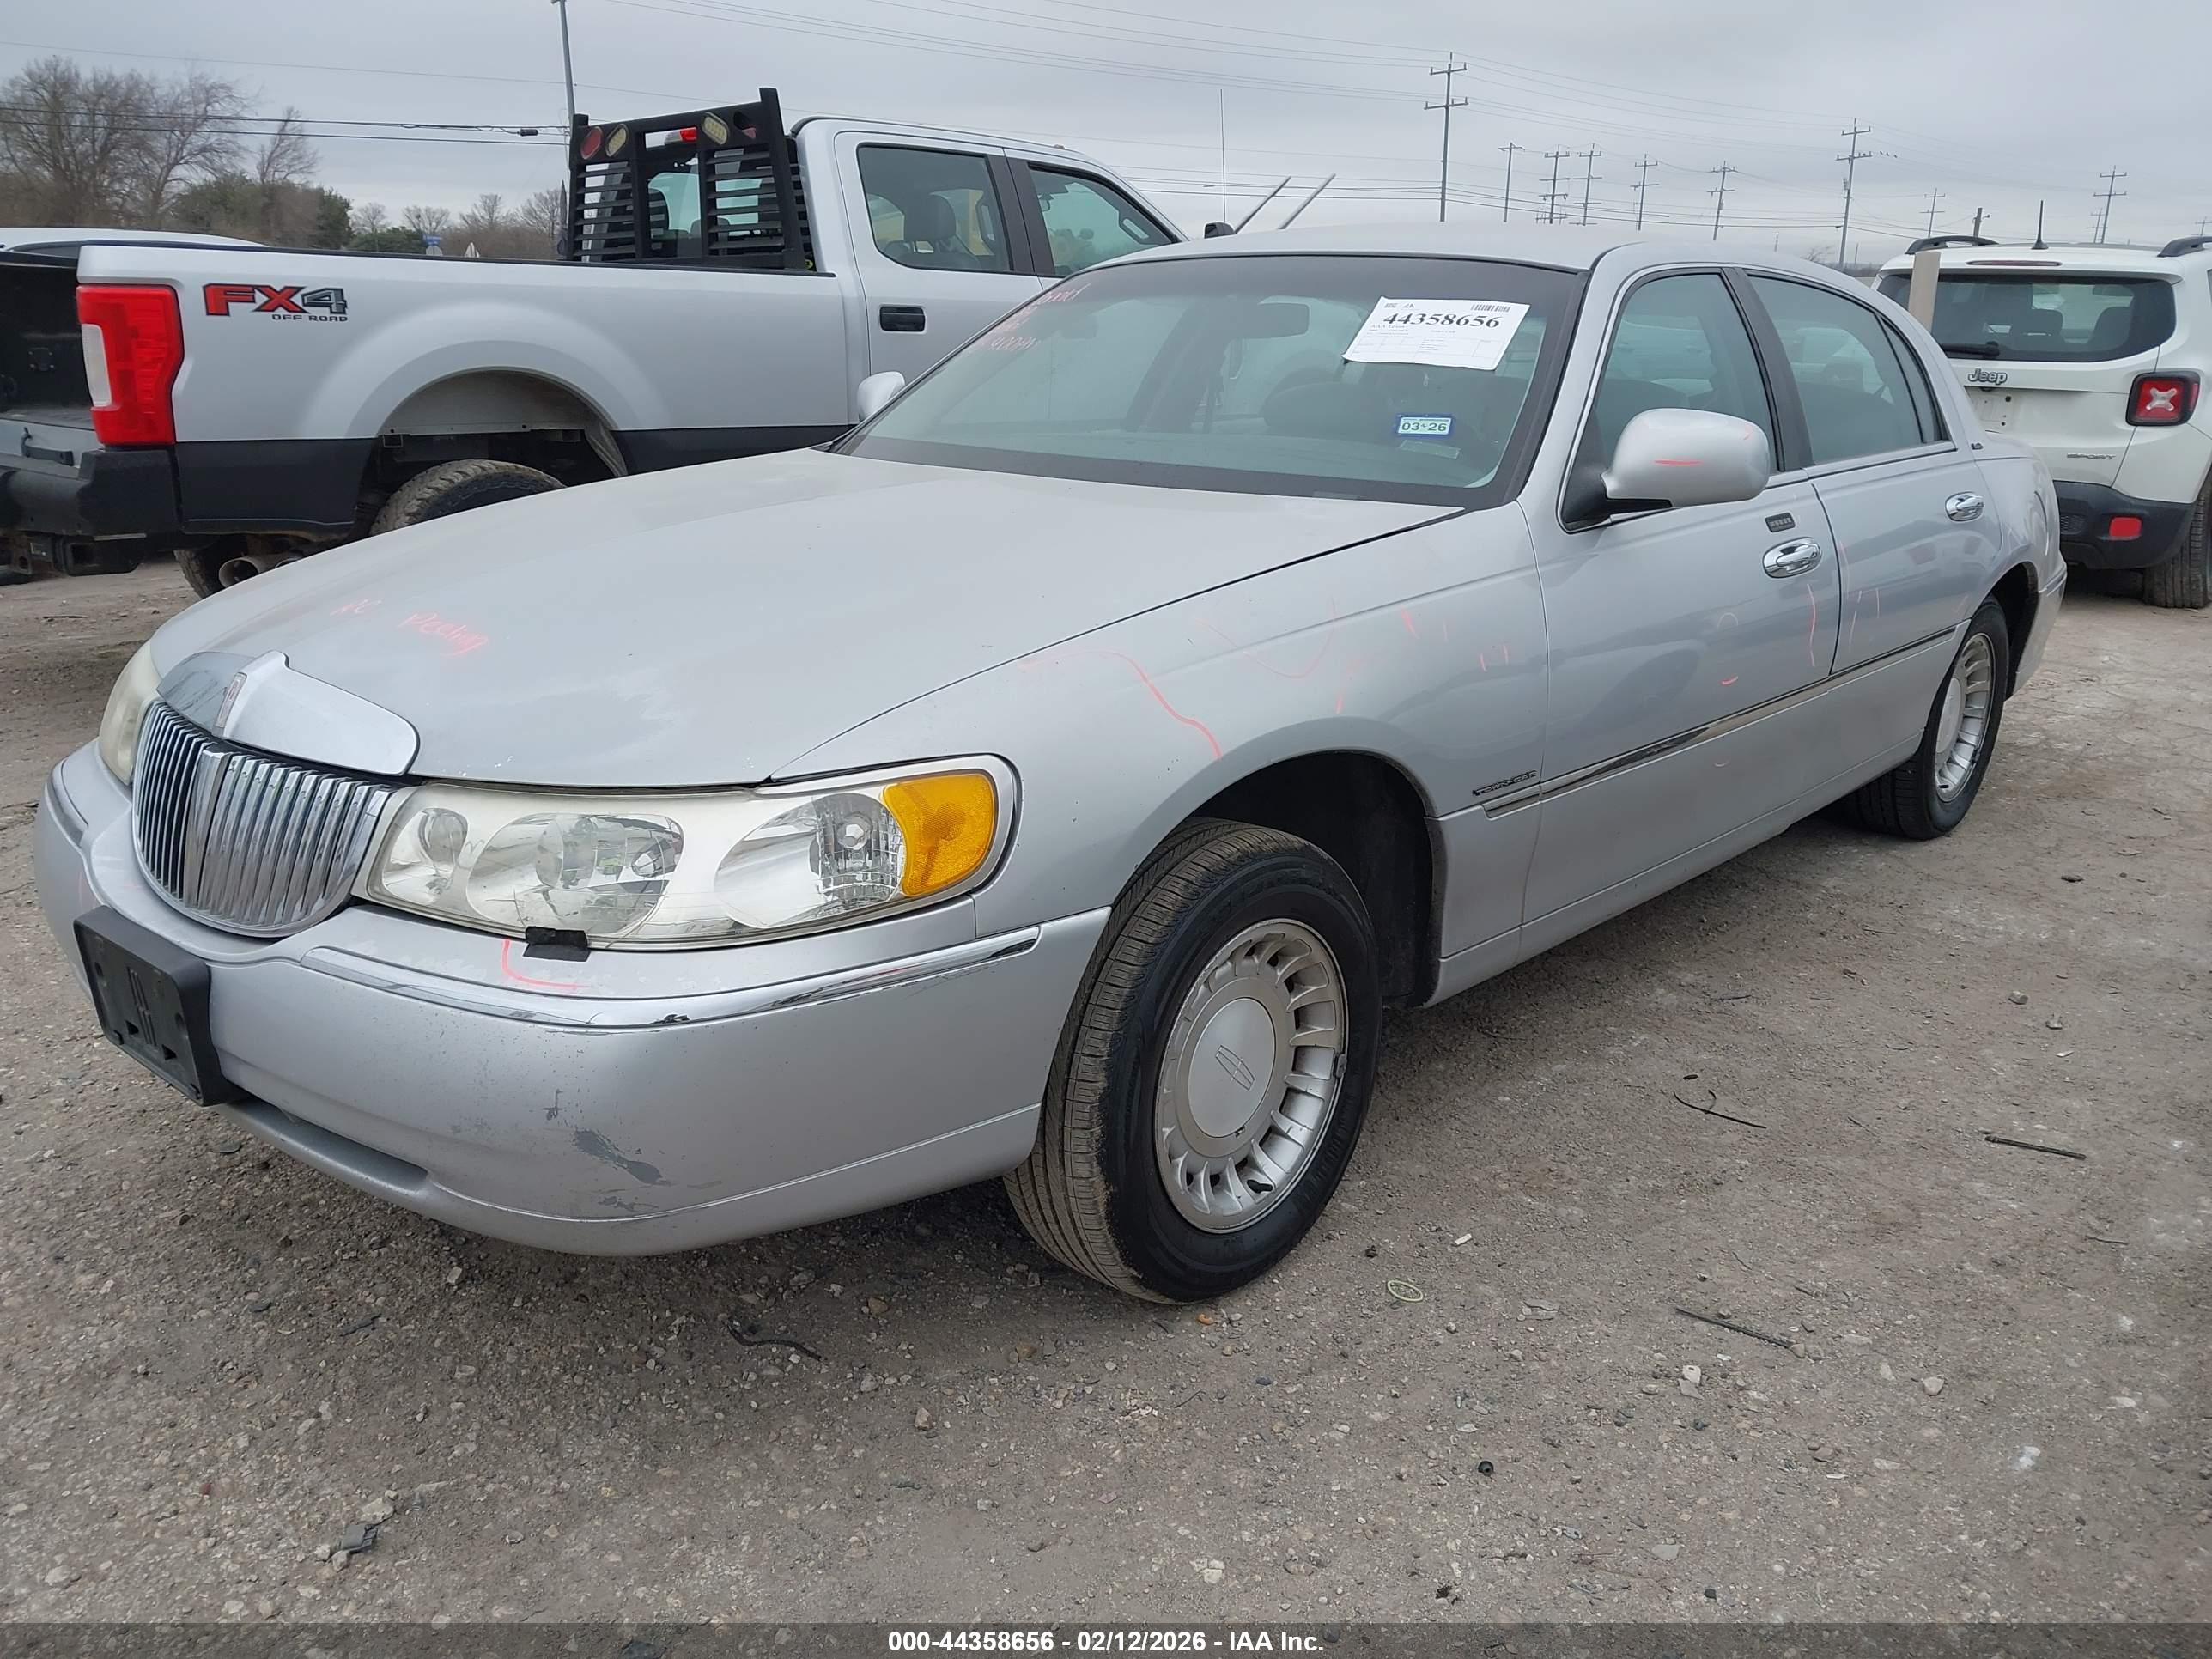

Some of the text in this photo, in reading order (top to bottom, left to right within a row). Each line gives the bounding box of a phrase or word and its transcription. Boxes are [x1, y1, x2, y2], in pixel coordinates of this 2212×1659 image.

[202, 283, 348, 316] FX4
[1382, 313, 1503, 328] 44358656
[1967, 368, 2008, 385] Jeep
[1401, 422, 1447, 432] 03 26
